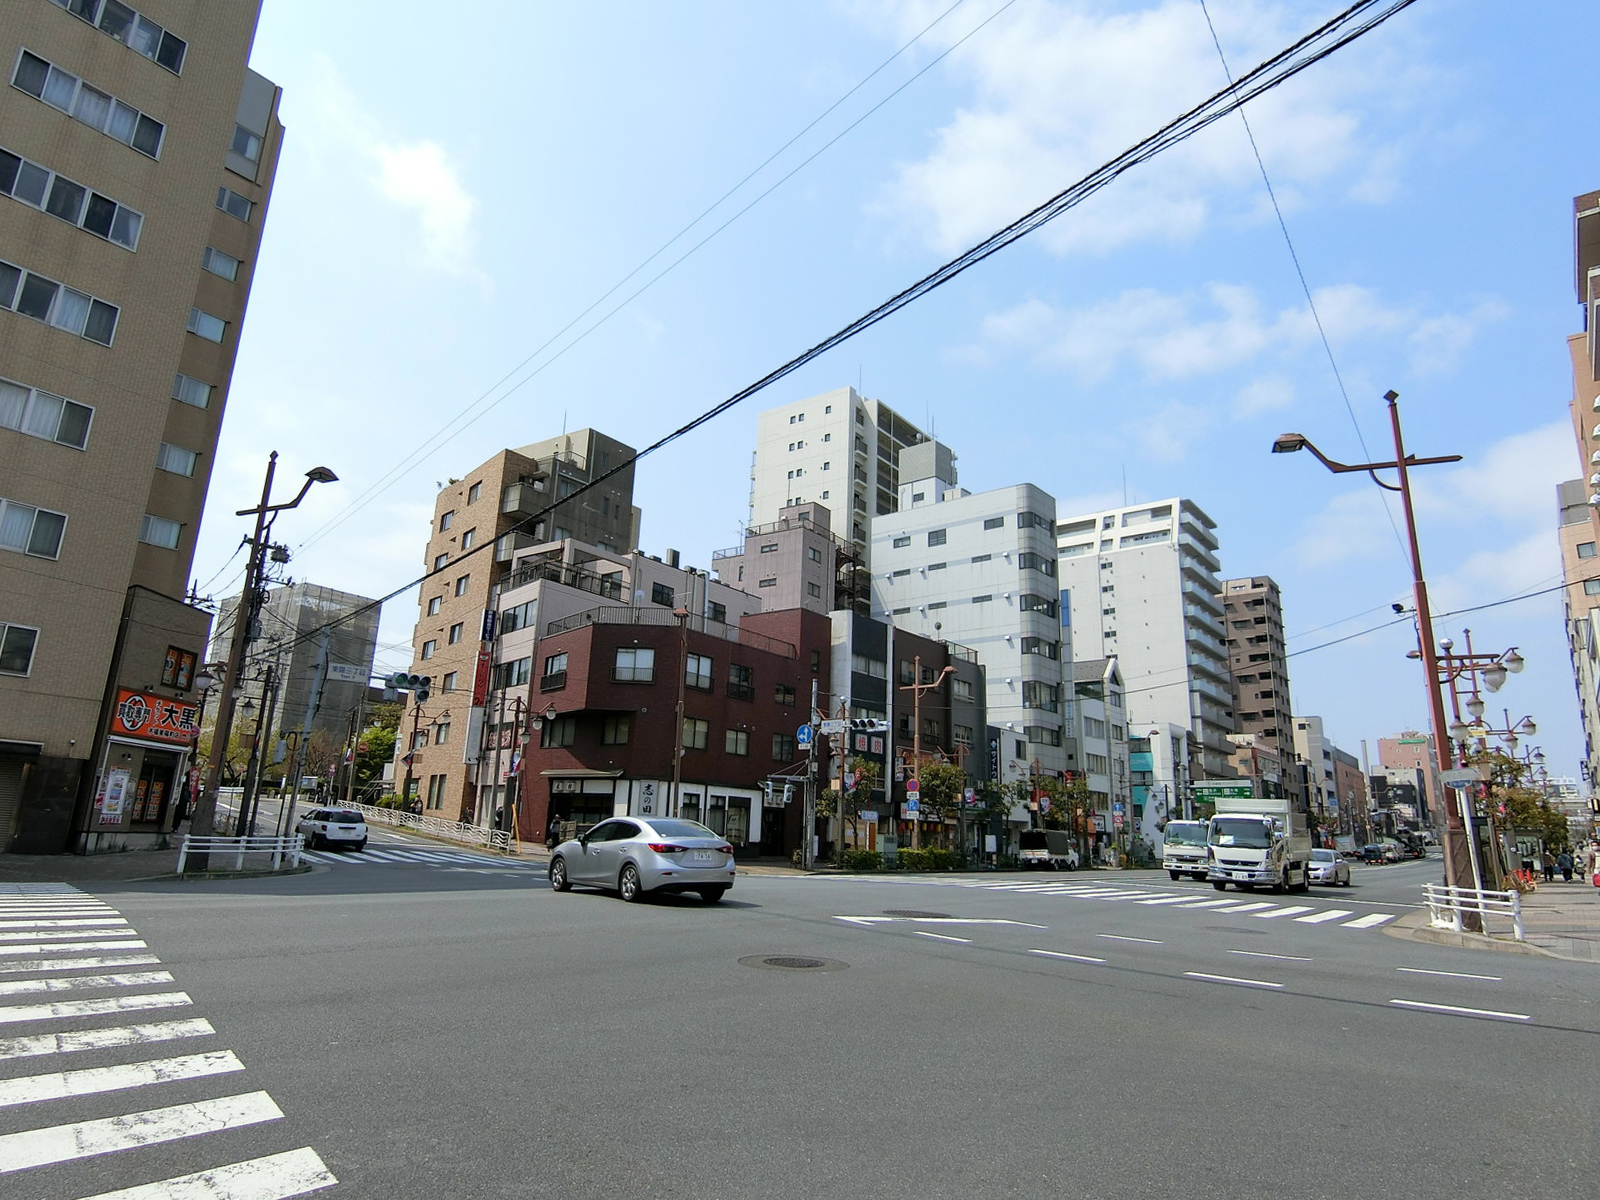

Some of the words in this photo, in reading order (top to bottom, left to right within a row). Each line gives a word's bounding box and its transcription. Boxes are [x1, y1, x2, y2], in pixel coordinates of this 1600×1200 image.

[117, 702, 151, 723] 買取専門
[161, 705, 196, 731] 大黒
[643, 784, 654, 814] 志の田
